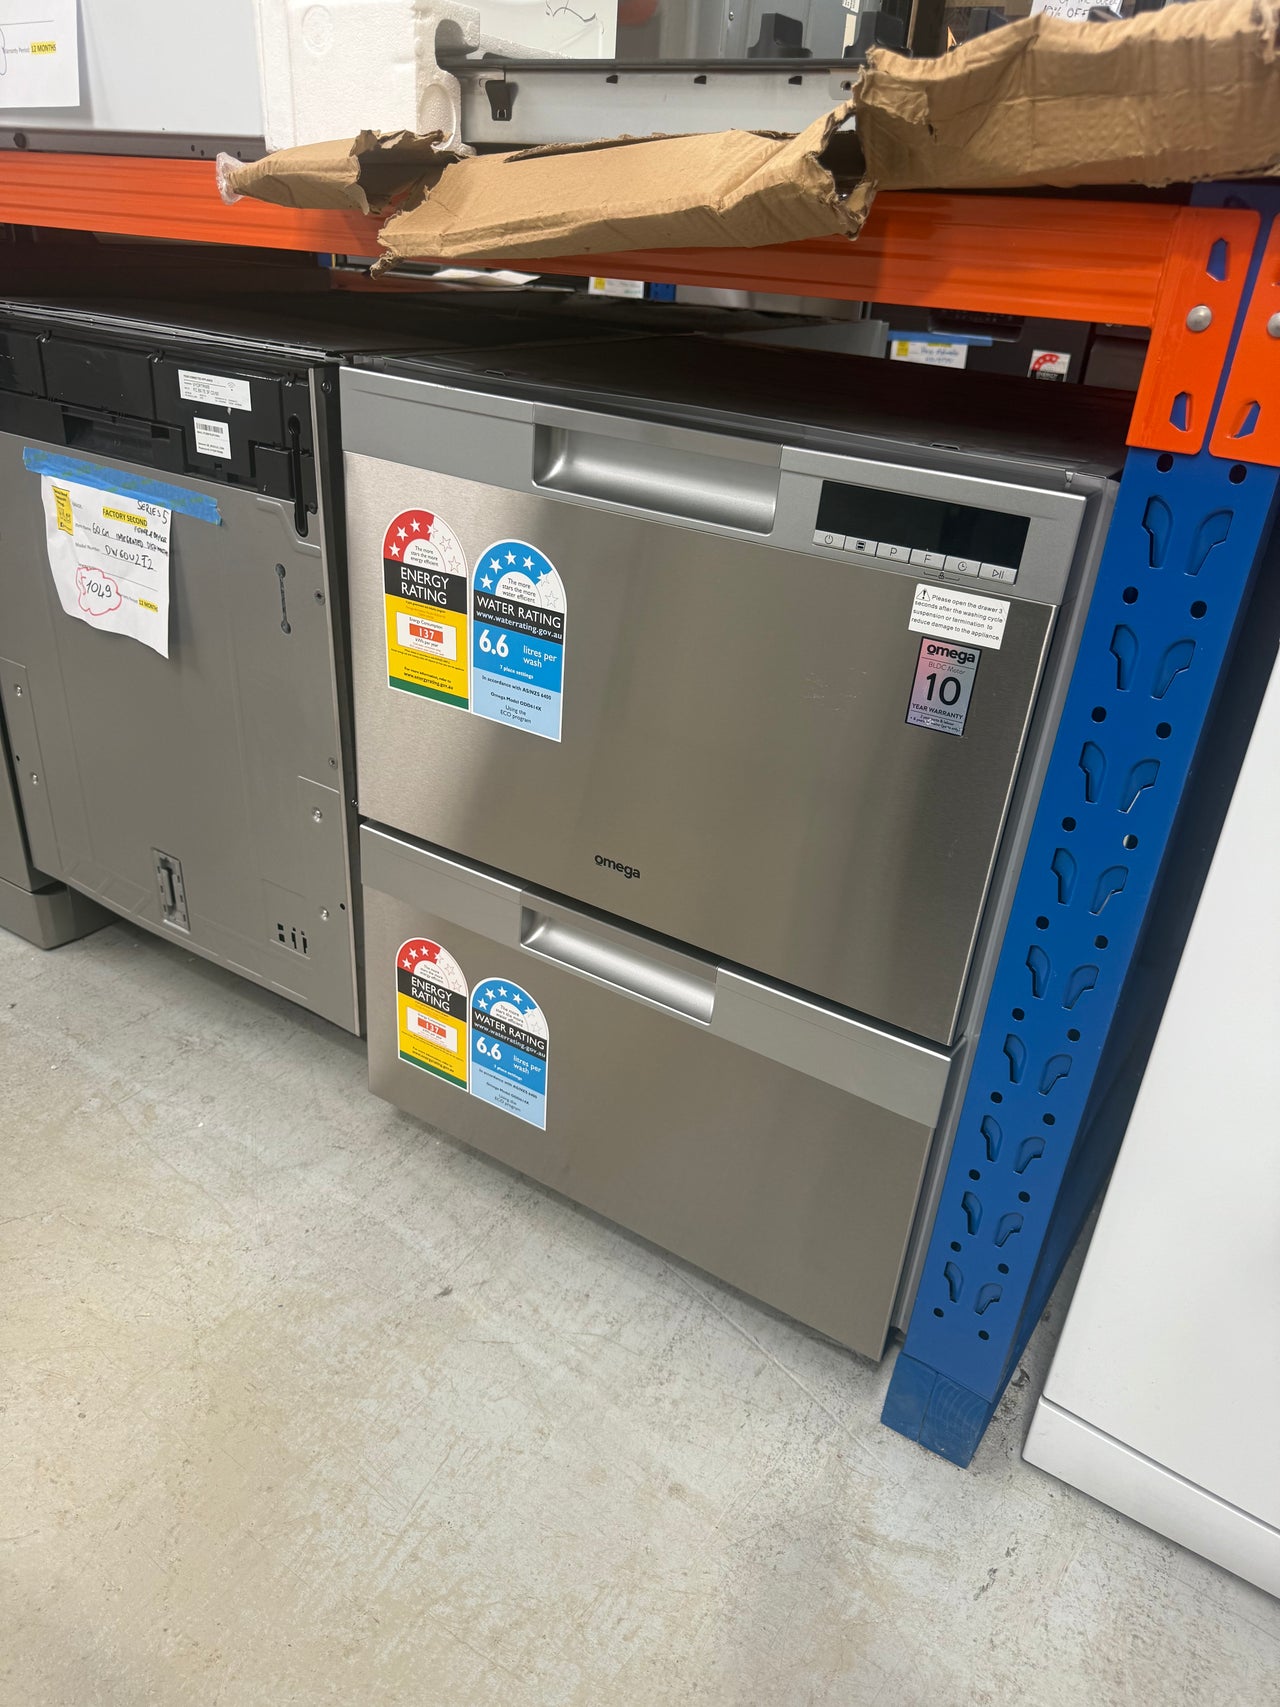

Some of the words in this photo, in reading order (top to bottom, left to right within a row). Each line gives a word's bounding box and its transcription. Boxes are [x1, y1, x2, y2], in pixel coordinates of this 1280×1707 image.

[37, 44, 57, 52] MONTHS
[102, 508, 126, 521] FACTORY
[126, 515, 148, 527] SECOND
[161, 510, 169, 525] 5
[890, 547, 897, 557] P
[924, 554, 932, 563] F
[401, 566, 450, 590] ENERGY
[518, 581, 531, 589] more
[401, 581, 447, 605] RATING
[517, 594, 535, 603] efficient
[477, 595, 515, 616] WATER
[518, 607, 561, 629] RATING
[932, 594, 951, 603] Please
[952, 599, 966, 607] open
[978, 604, 998, 613] drawer
[913, 609, 944, 620] suspension
[952, 616, 984, 628] termination
[939, 604, 952, 612] after
[953, 606, 962, 614] the
[963, 610, 986, 620] washing
[988, 615, 1003, 623] cycle
[421, 620, 443, 630] Consumption
[476, 611, 562, 640] www.waterrating.gov.au
[911, 617, 930, 625] reduce
[931, 621, 953, 631] damage
[419, 628, 435, 640] 137
[479, 629, 509, 658] 6.6
[523, 644, 542, 658] litres
[544, 653, 557, 662] per
[927, 644, 975, 664] omega
[523, 657, 542, 668] wash
[928, 661, 946, 671] BLDC
[947, 665, 965, 675] Motor
[503, 666, 515, 674] place
[516, 669, 534, 680] settings
[488, 676, 511, 688] accordance
[522, 687, 540, 697] AS/NZS
[926, 673, 961, 706] 10
[491, 691, 506, 700] Omega
[506, 696, 520, 704] Model
[500, 709, 511, 718] ECO
[512, 713, 531, 724] program
[505, 705, 518, 715] Using
[912, 703, 928, 711] YEAR
[929, 707, 963, 720] WARRANTY
[594, 855, 640, 879] omega
[411, 976, 452, 1001] ENERGY
[411, 987, 450, 1012] RATING
[509, 1009, 519, 1017] more
[426, 1022, 439, 1034] 137
[474, 1011, 506, 1033] WATER
[509, 1027, 545, 1050] RATING
[474, 1022, 546, 1058] www.waterrating.gov.au
[476, 1036, 502, 1060] 6.6
[513, 1054, 529, 1067] litres
[530, 1064, 541, 1072] per
[513, 1063, 529, 1075] wash
